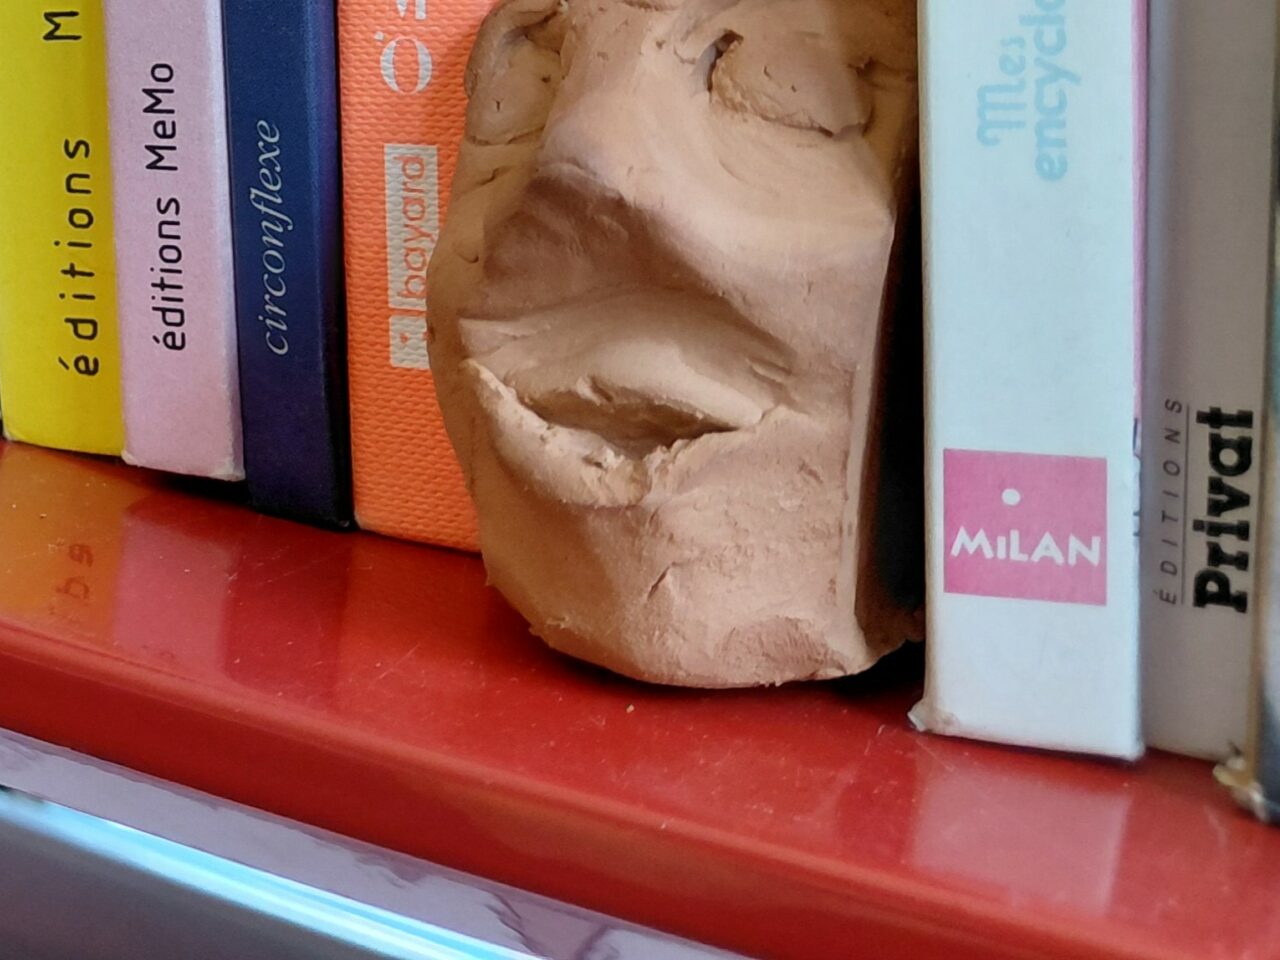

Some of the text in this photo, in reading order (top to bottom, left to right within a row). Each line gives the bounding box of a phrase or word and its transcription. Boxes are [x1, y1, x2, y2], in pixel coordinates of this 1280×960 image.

[976, 35, 1027, 147] Mes
[53, 137, 101, 378] éditions
[142, 61, 186, 352] éditions MeMo
[248, 119, 294, 356] circonflexe
[393, 154, 438, 302] bayard
[1152, 396, 1183, 607] ÉDITIONS
[1191, 406, 1254, 615] Privat
